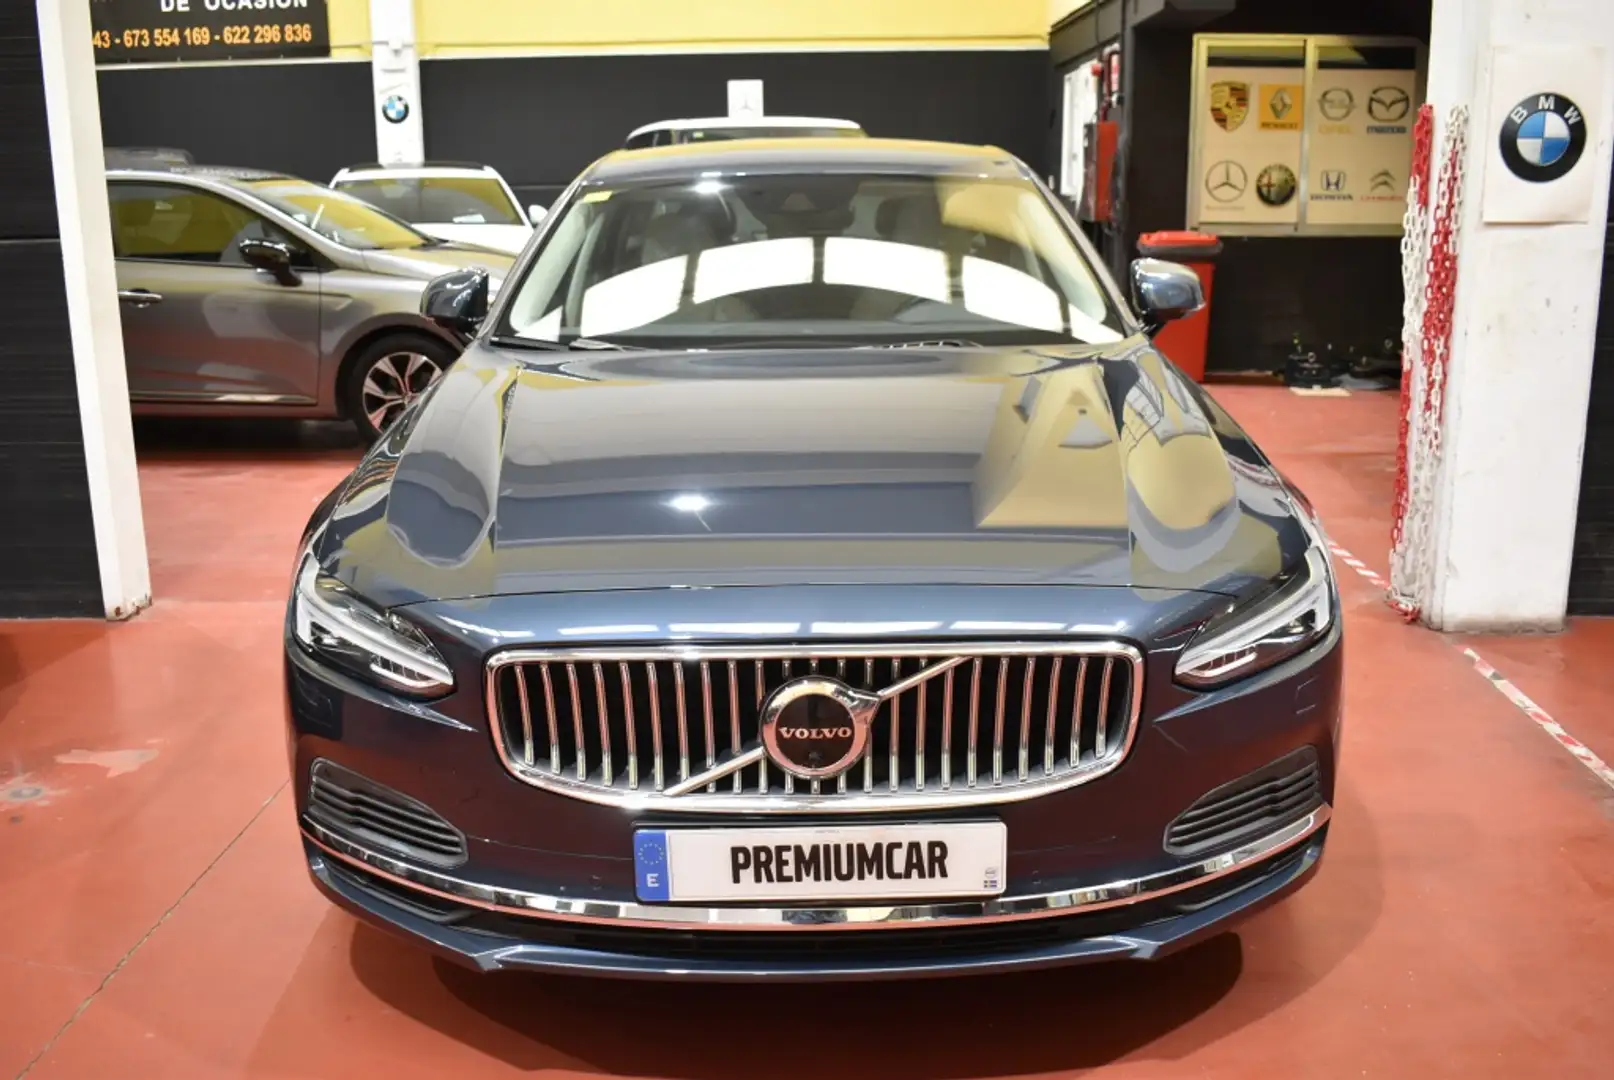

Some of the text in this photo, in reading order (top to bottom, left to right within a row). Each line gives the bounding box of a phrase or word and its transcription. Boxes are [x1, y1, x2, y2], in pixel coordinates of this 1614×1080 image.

[160, 0, 190, 12] DE
[123, 28, 150, 47] 673
[154, 27, 180, 47] 554
[184, 26, 210, 45] 169
[223, 25, 251, 44] 622
[253, 24, 281, 43] 296
[284, 23, 312, 42] 836
[1510, 95, 1581, 125] BMW
[779, 726, 852, 739] VOLVO
[730, 840, 949, 884] PREMIUMCAR
[646, 873, 659, 888] E
